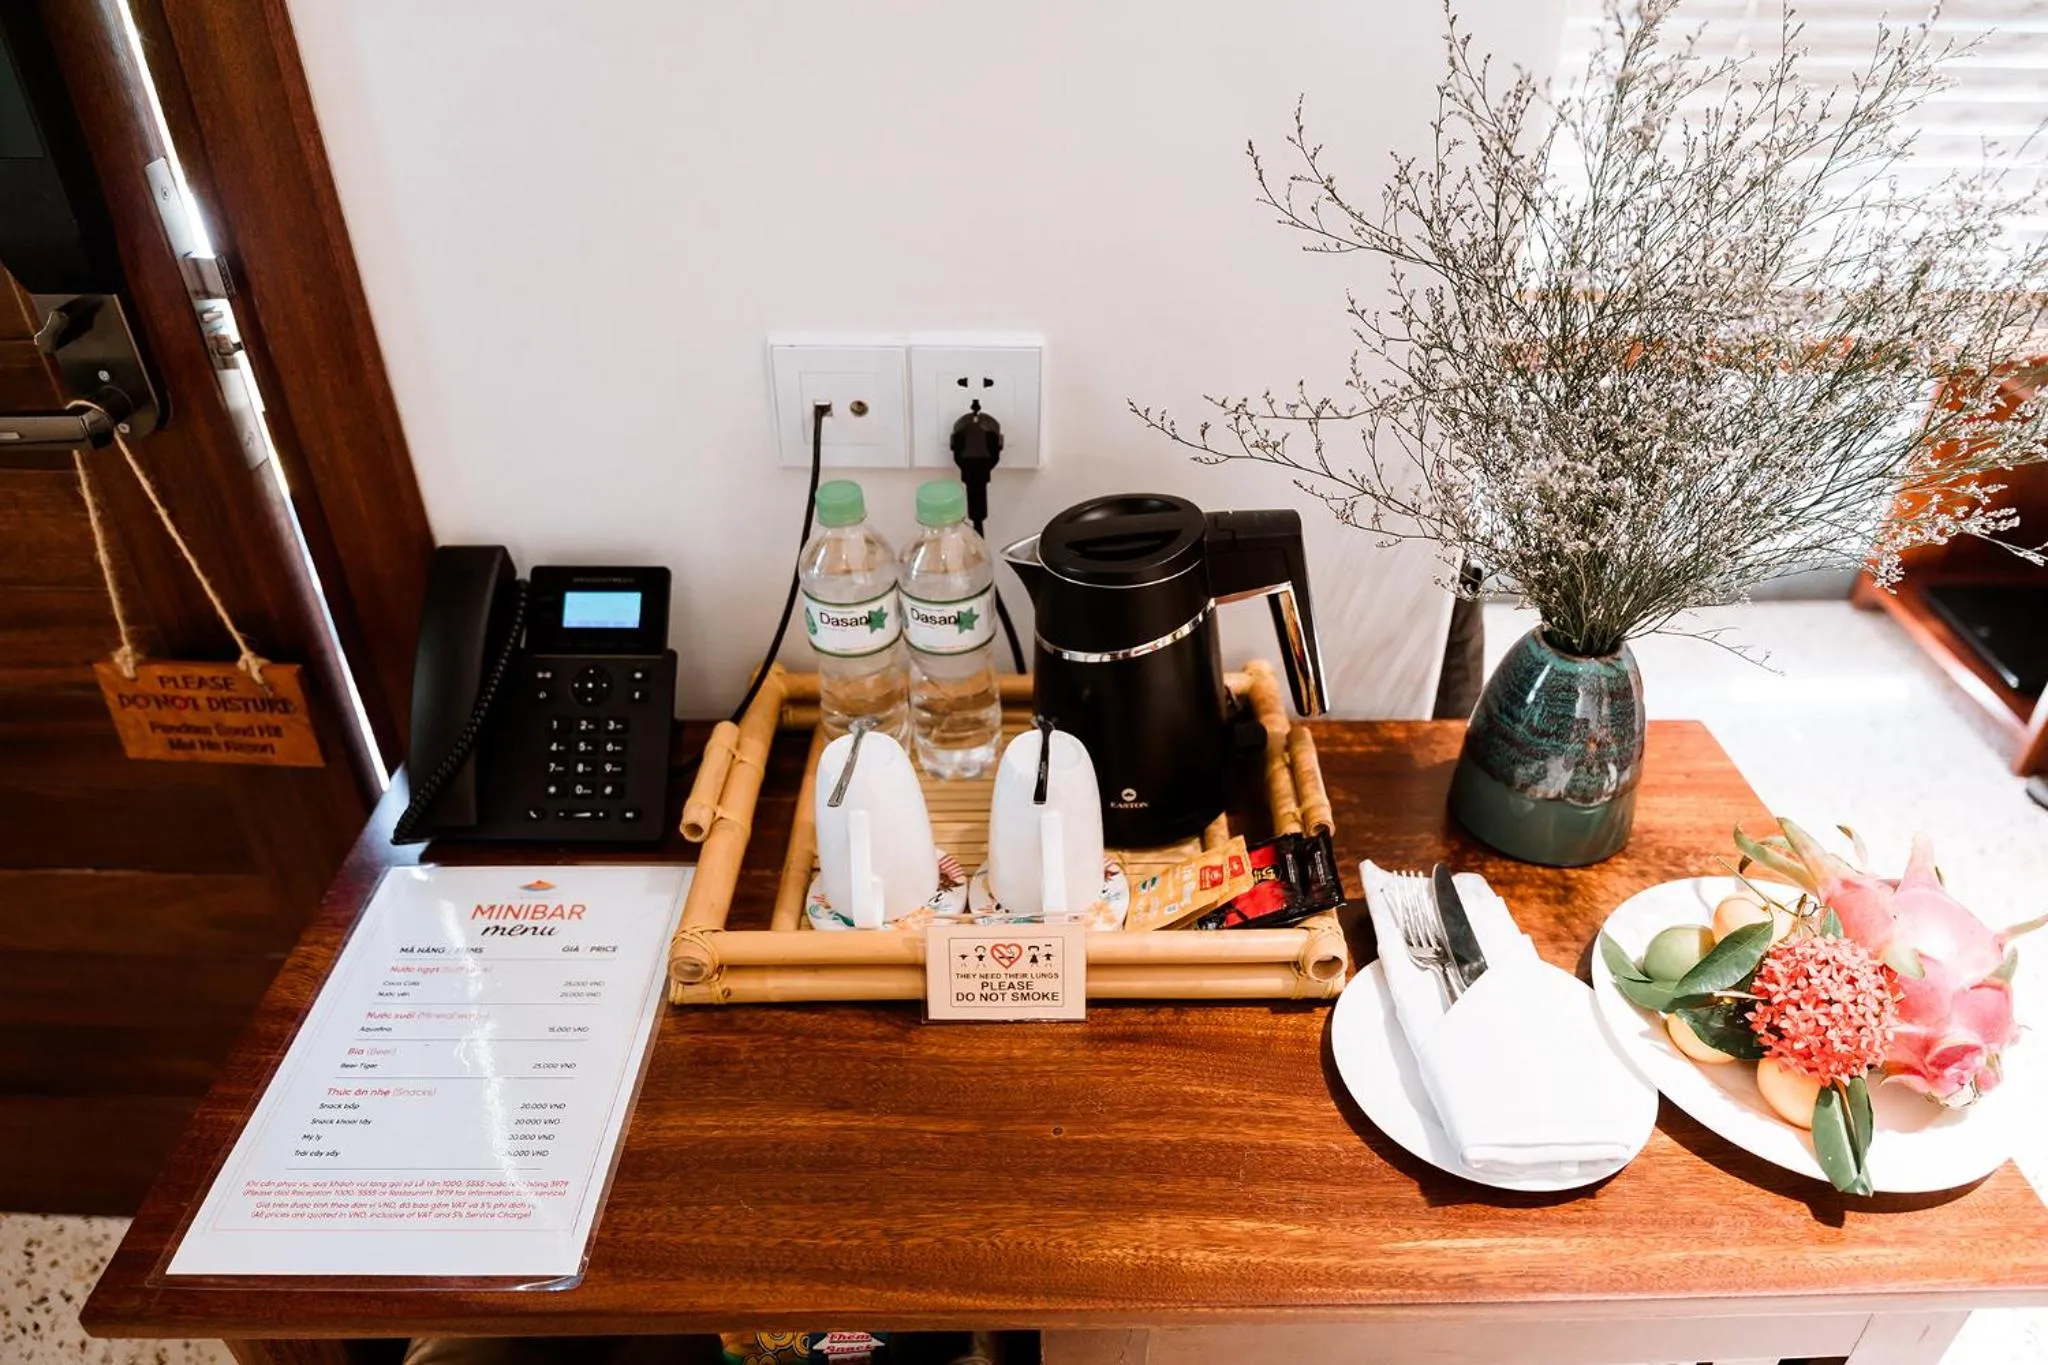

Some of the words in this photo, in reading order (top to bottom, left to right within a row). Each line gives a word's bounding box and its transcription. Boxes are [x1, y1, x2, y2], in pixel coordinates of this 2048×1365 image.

[157, 675, 236, 690] PLEASE
[118, 693, 150, 710] DO
[155, 695, 201, 711] NOT
[206, 696, 297, 714] DISTURB
[471, 904, 587, 920] MINIBAR
[481, 924, 560, 936] menu
[981, 981, 1034, 991] PLEASE
[956, 992, 975, 1002] DO
[979, 992, 1007, 1002] NOT
[1011, 992, 1060, 1001] SMOKE
